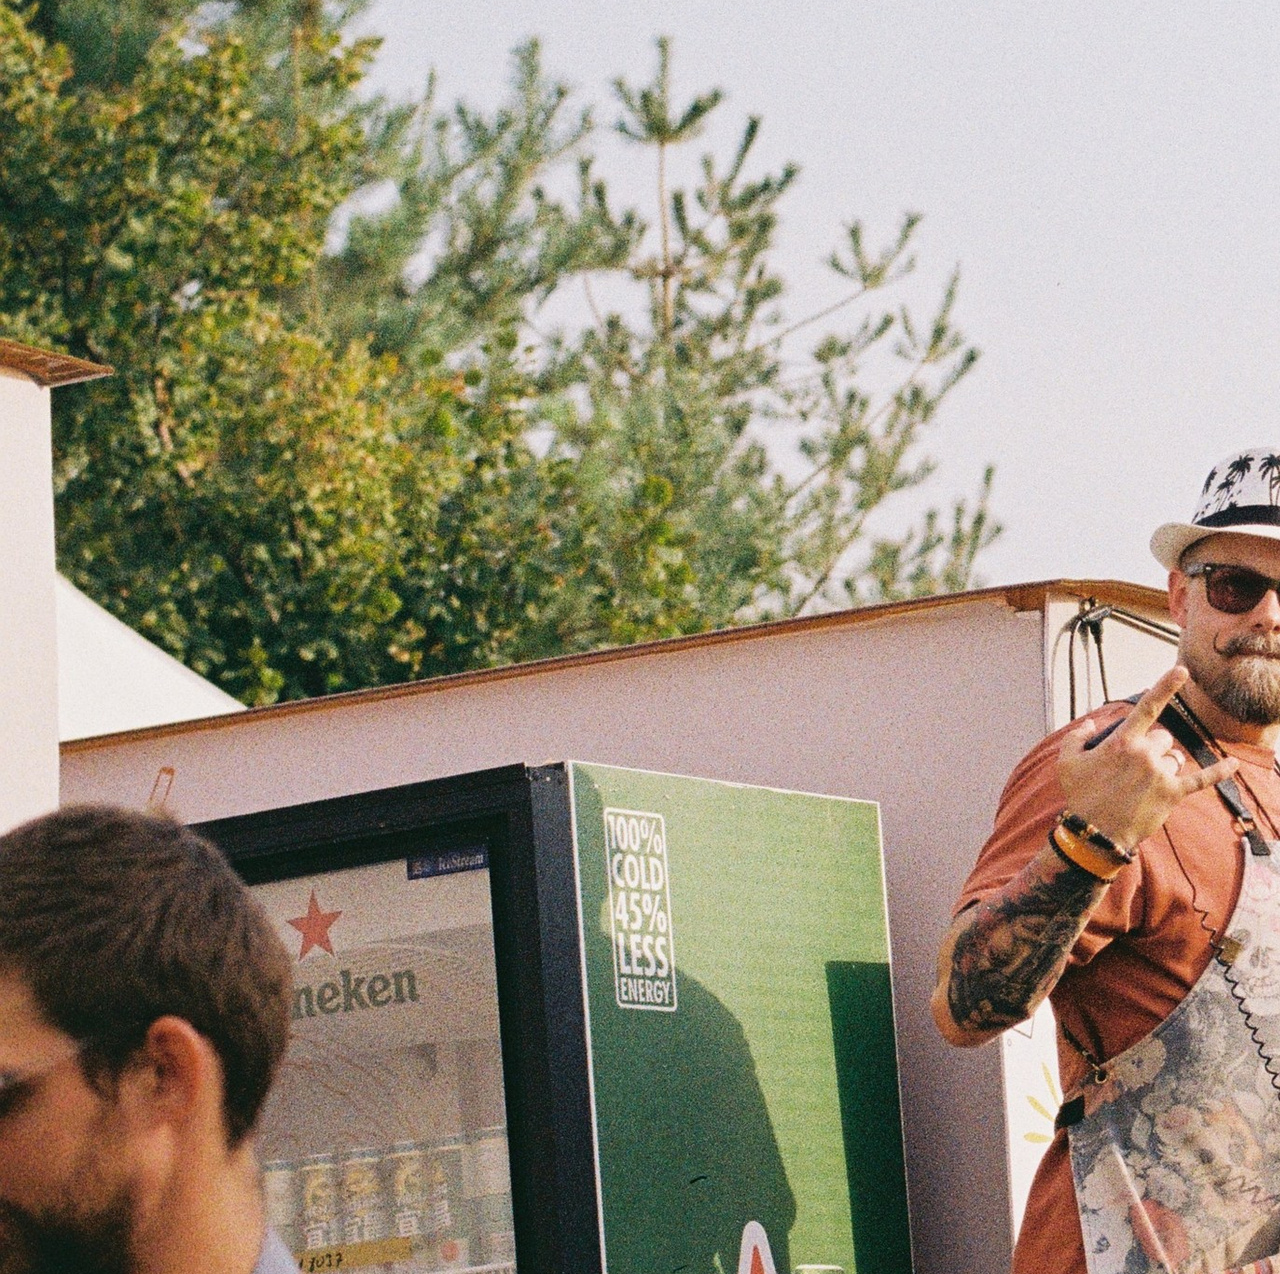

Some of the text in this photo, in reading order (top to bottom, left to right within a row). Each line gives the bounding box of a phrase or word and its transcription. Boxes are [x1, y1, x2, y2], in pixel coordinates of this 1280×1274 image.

[607, 813, 663, 855] 100%
[612, 852, 663, 892] COLD
[615, 891, 667, 933] 45%
[618, 932, 669, 977] LESS
[292, 969, 420, 1020] neken
[620, 977, 671, 1004] ENERGY
